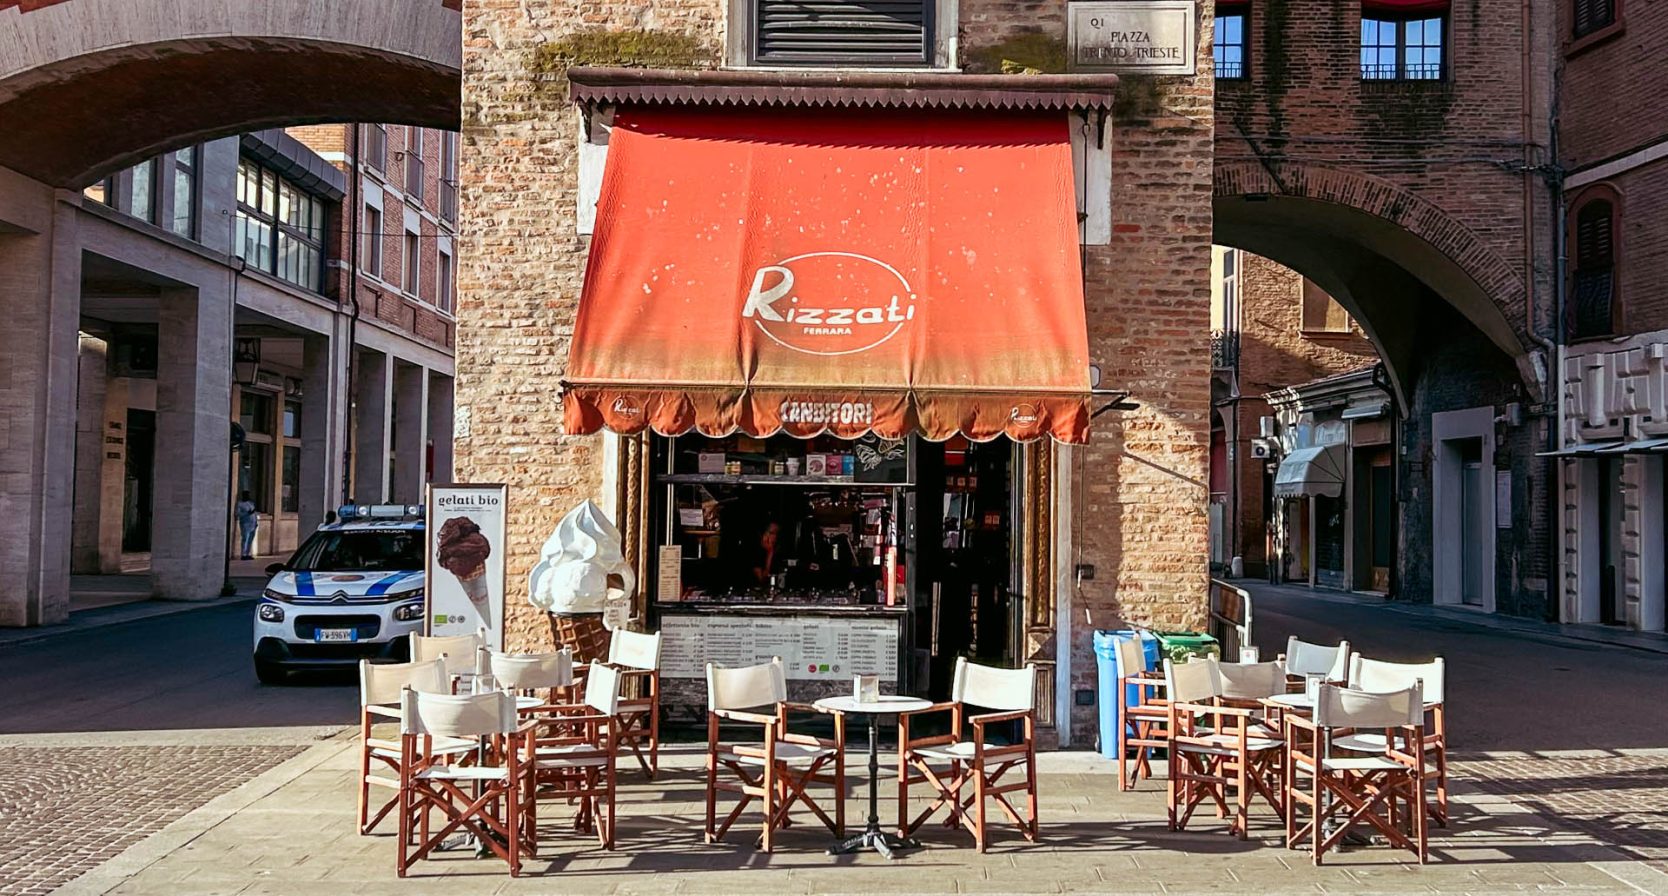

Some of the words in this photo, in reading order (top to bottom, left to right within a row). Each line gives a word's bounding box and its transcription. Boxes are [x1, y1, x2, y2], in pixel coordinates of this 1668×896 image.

[1111, 31, 1150, 42] PIAZZA
[1135, 47, 1180, 59] TRIESTE
[742, 265, 917, 325] Rizzati
[803, 327, 852, 335] FERRARA
[438, 495, 474, 507] gelati
[478, 495, 499, 505] bio
